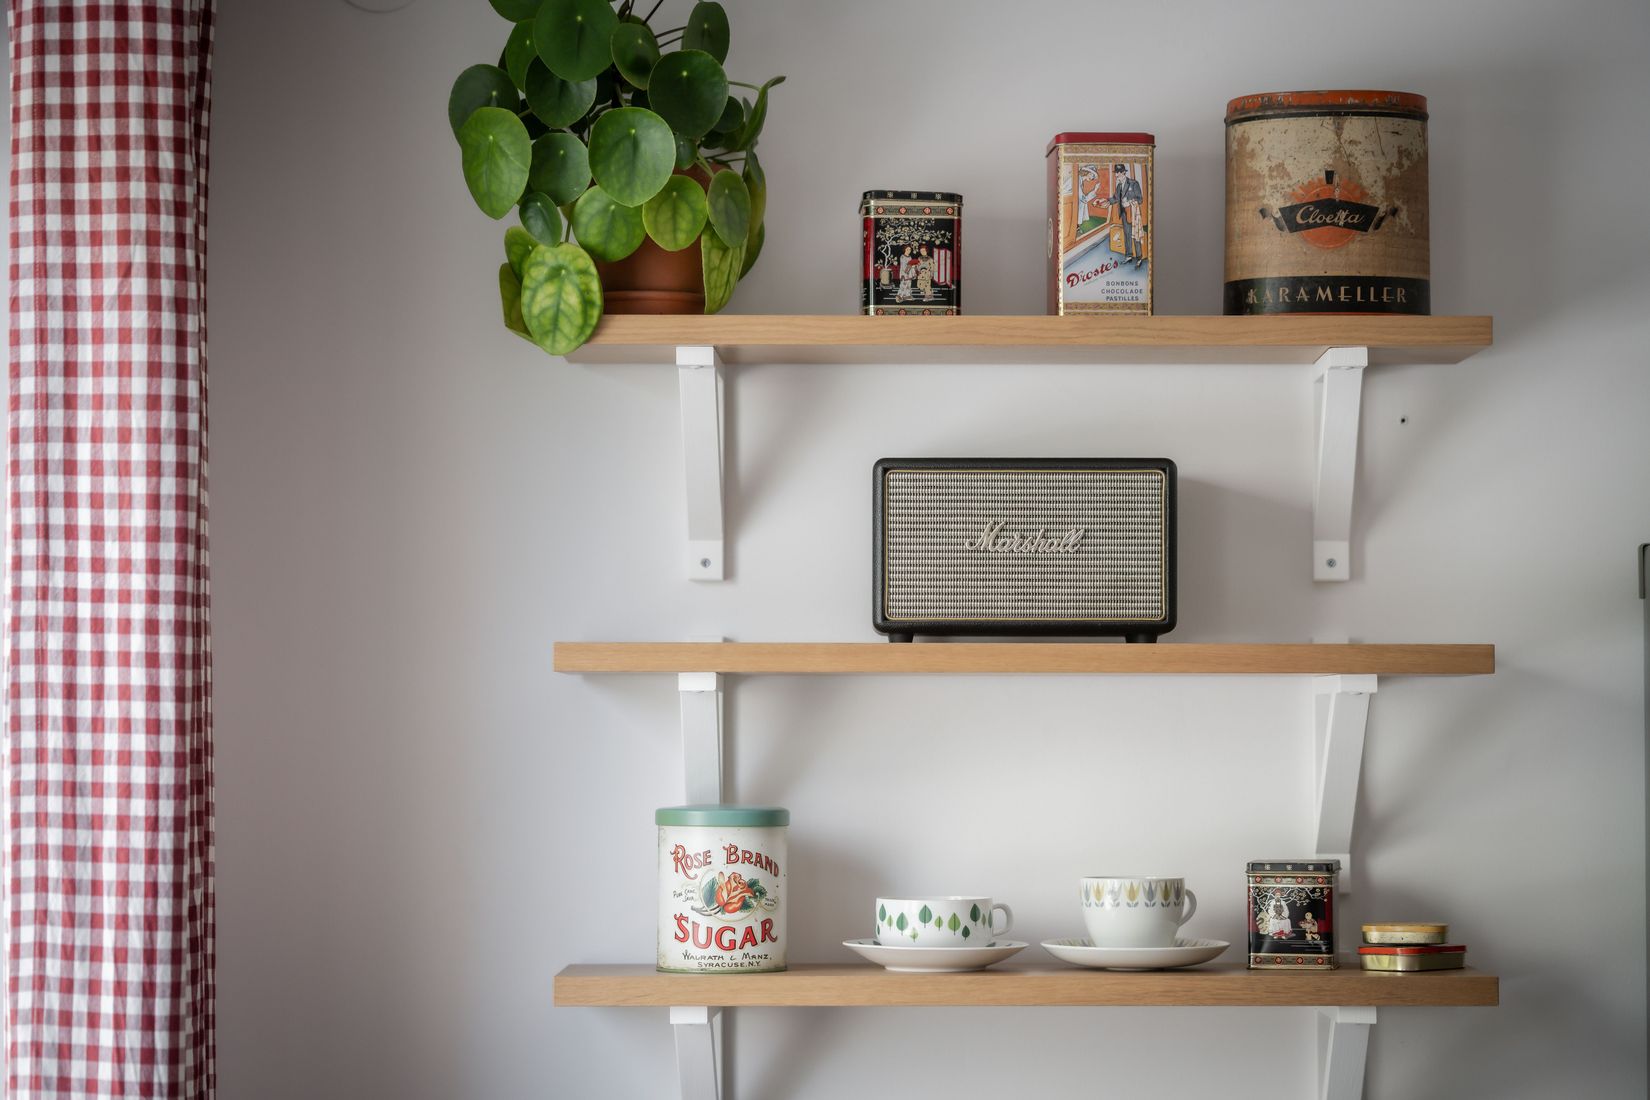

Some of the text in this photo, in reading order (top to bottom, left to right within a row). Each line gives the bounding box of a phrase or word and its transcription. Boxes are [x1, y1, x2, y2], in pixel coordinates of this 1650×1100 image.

[1296, 205, 1364, 225] Cloetta
[1247, 286, 1407, 304] KARAMELLER
[965, 520, 1085, 553] Marshall
[674, 913, 778, 951] SUGAR
